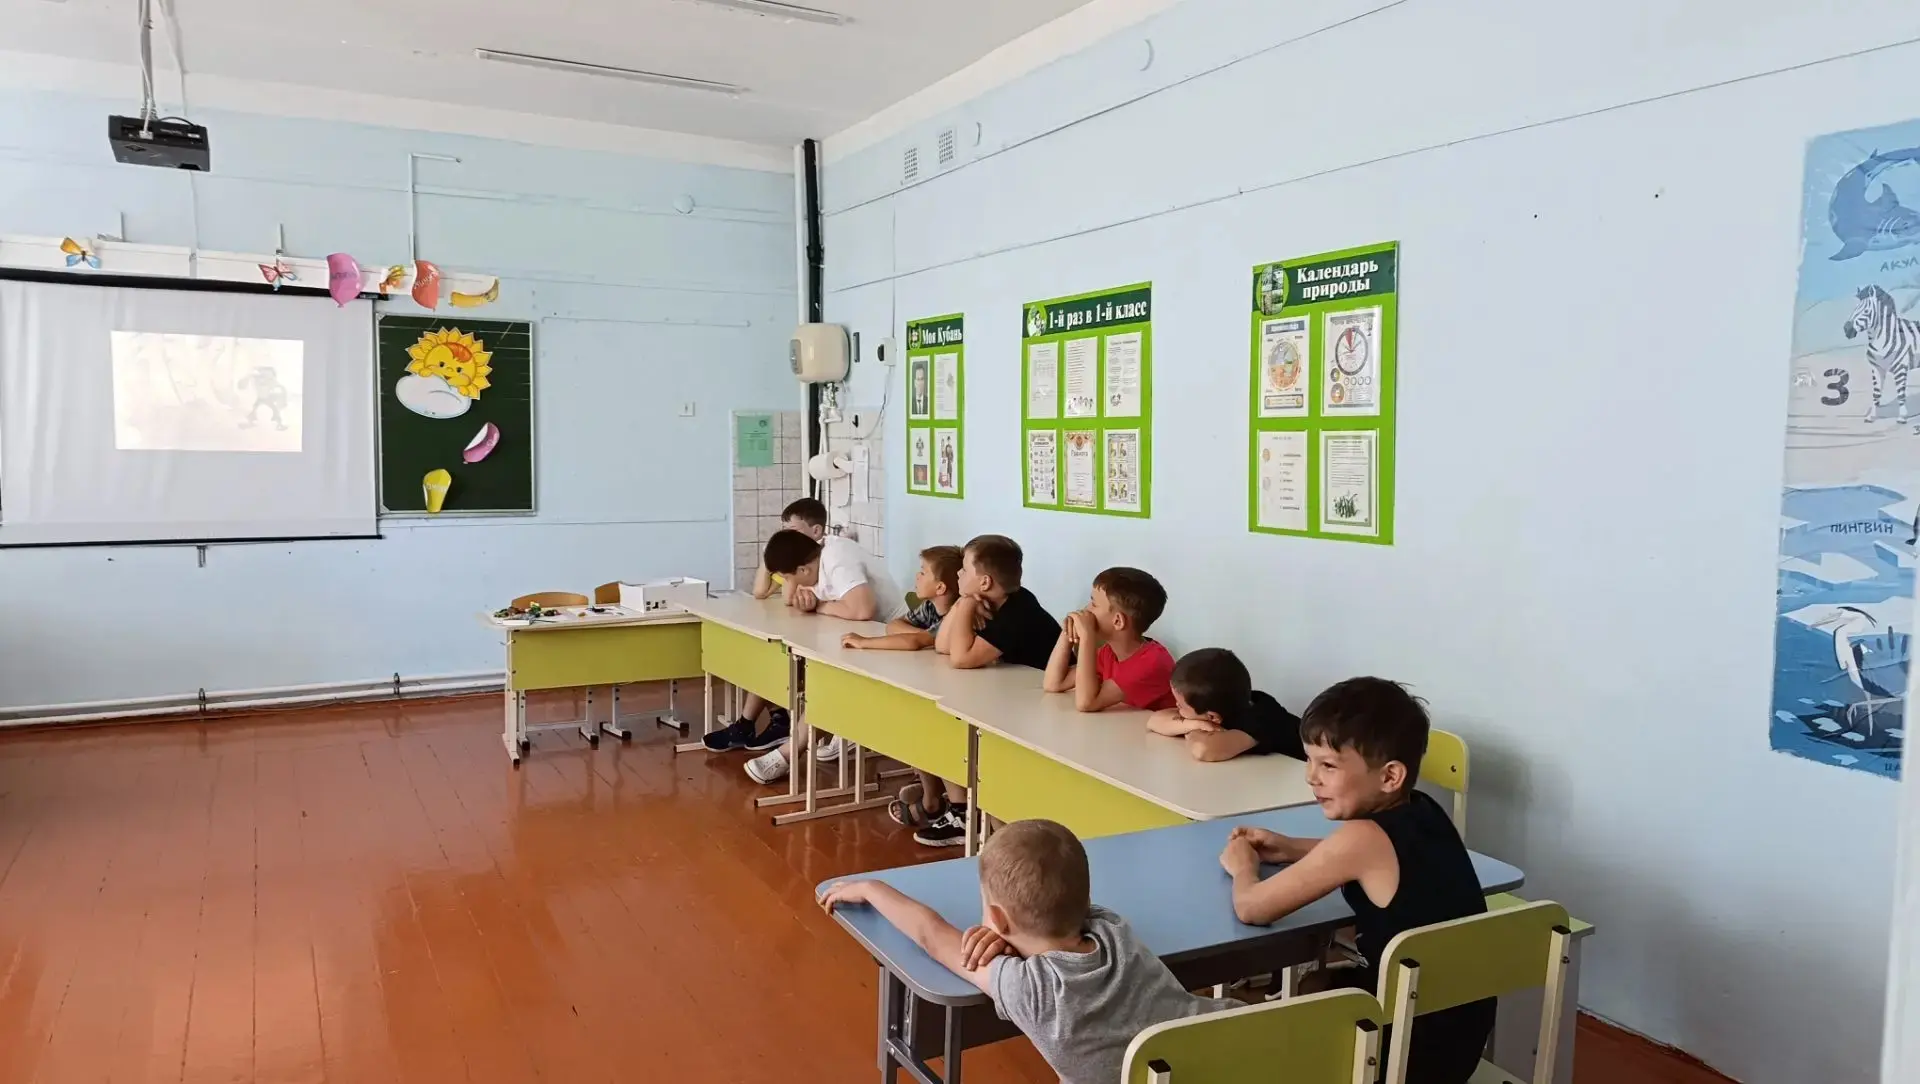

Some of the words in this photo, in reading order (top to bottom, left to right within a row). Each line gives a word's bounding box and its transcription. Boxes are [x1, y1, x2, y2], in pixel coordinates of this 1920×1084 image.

[1297, 260, 1379, 283] Календарь
[1302, 278, 1371, 300] природы
[1049, 309, 1065, 329] 1-й
[1067, 311, 1083, 330] раз
[1086, 310, 1092, 323] в
[1096, 301, 1113, 322] 1-й
[1115, 301, 1147, 319] класс
[922, 329, 936, 345] Моя
[937, 325, 963, 346] Кубань
[1830, 522, 1893, 534] ПИНГВИН
